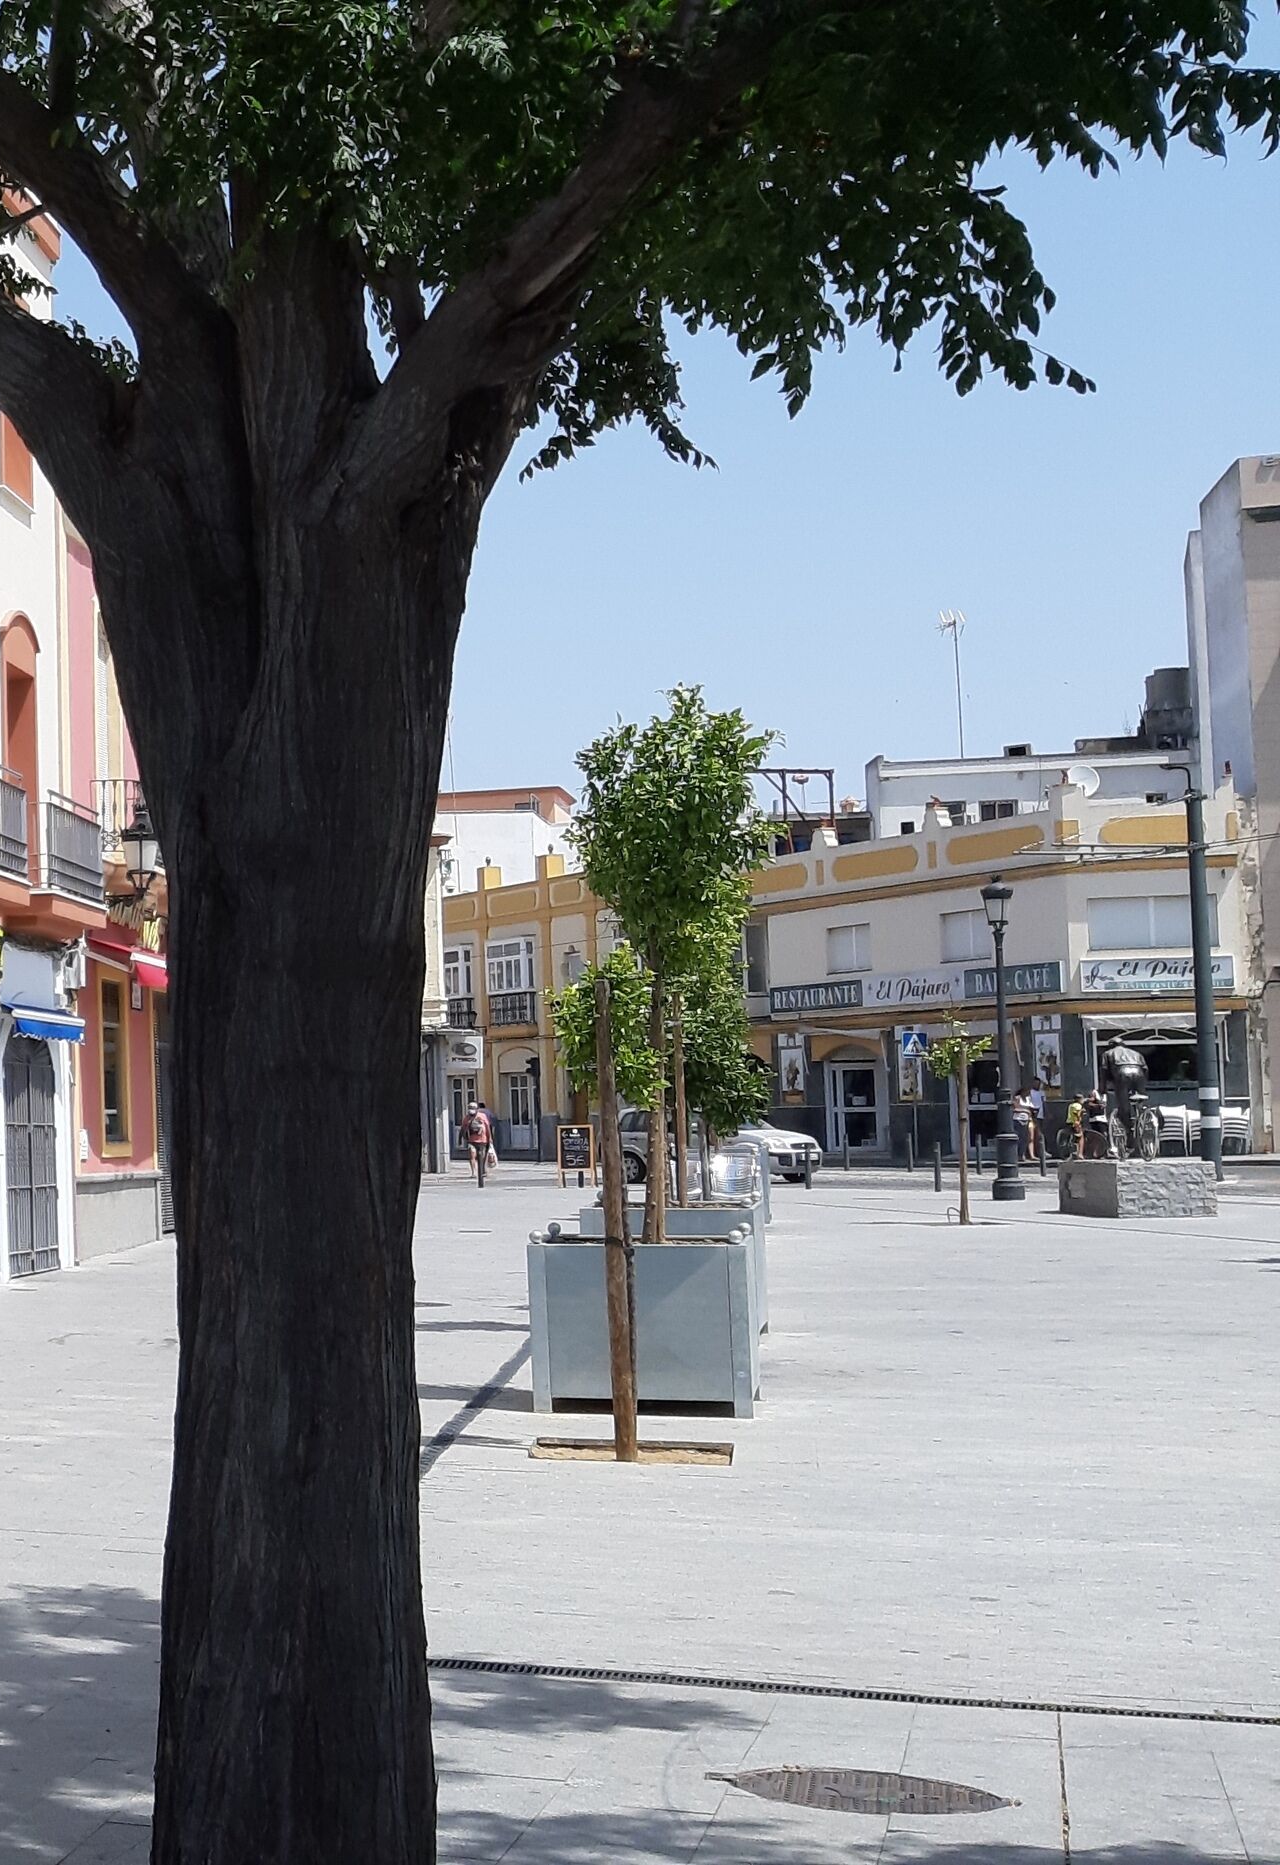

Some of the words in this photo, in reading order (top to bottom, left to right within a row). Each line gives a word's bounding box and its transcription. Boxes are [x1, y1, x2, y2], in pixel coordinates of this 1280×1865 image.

[1117, 960, 1140, 977] El
[1144, 959, 1221, 978] Pájo
[773, 983, 858, 1010] RESTAURANTE
[876, 979, 892, 1001] El
[895, 977, 951, 1002] Pájaro
[974, 971, 998, 994] BA
[1014, 963, 1051, 991] CAFÉ
